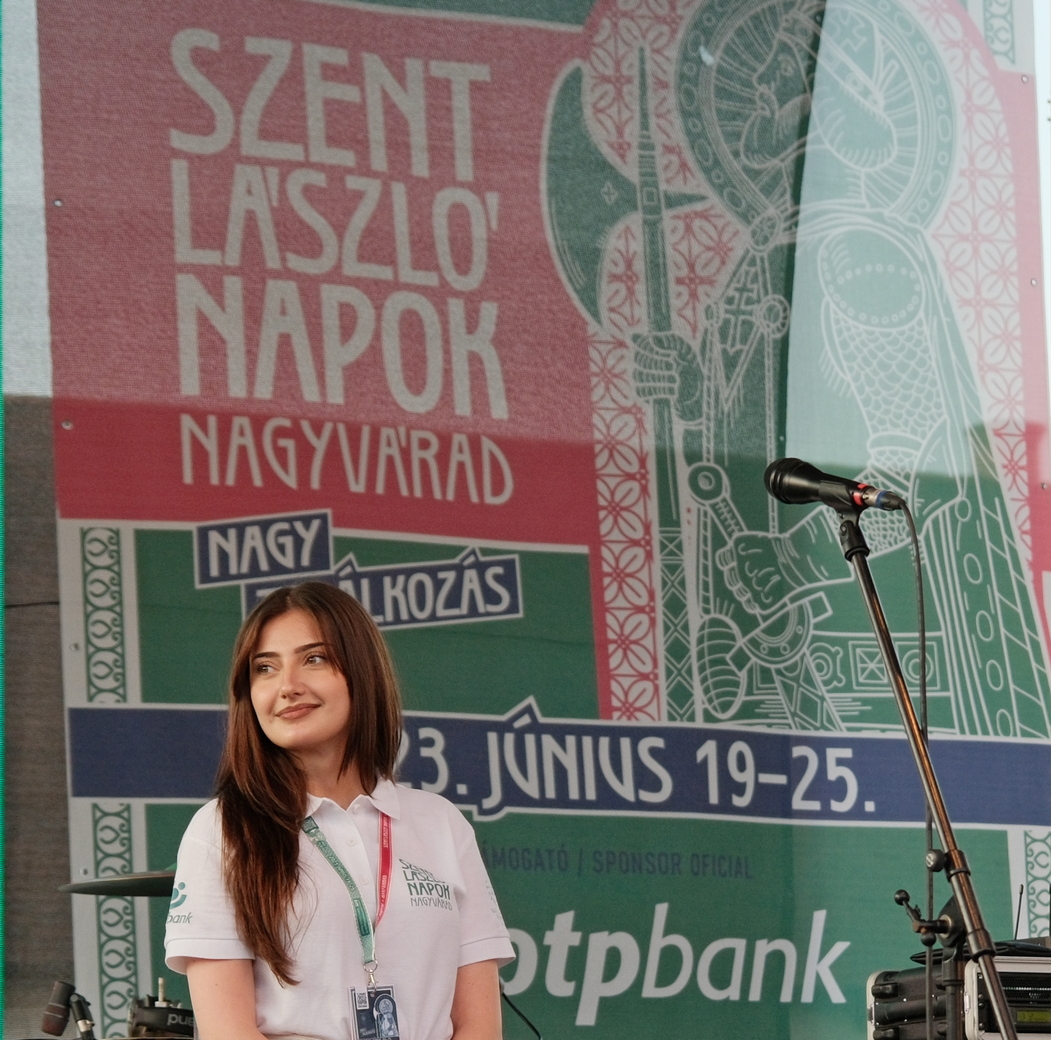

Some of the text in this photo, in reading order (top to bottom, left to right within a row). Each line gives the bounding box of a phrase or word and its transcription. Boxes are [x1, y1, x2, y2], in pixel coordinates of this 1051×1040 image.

[169, 28, 491, 182] SZENT
[170, 158, 499, 292] LÁSZLÓ
[175, 272, 509, 420] NAPOK
[179, 413, 514, 506] NAGYVÁRAD
[207, 518, 322, 577] NAGY
[481, 714, 673, 809] JÚNIUS
[592, 851, 682, 876] SPONSOR
[690, 852, 754, 880] OFICIAL
